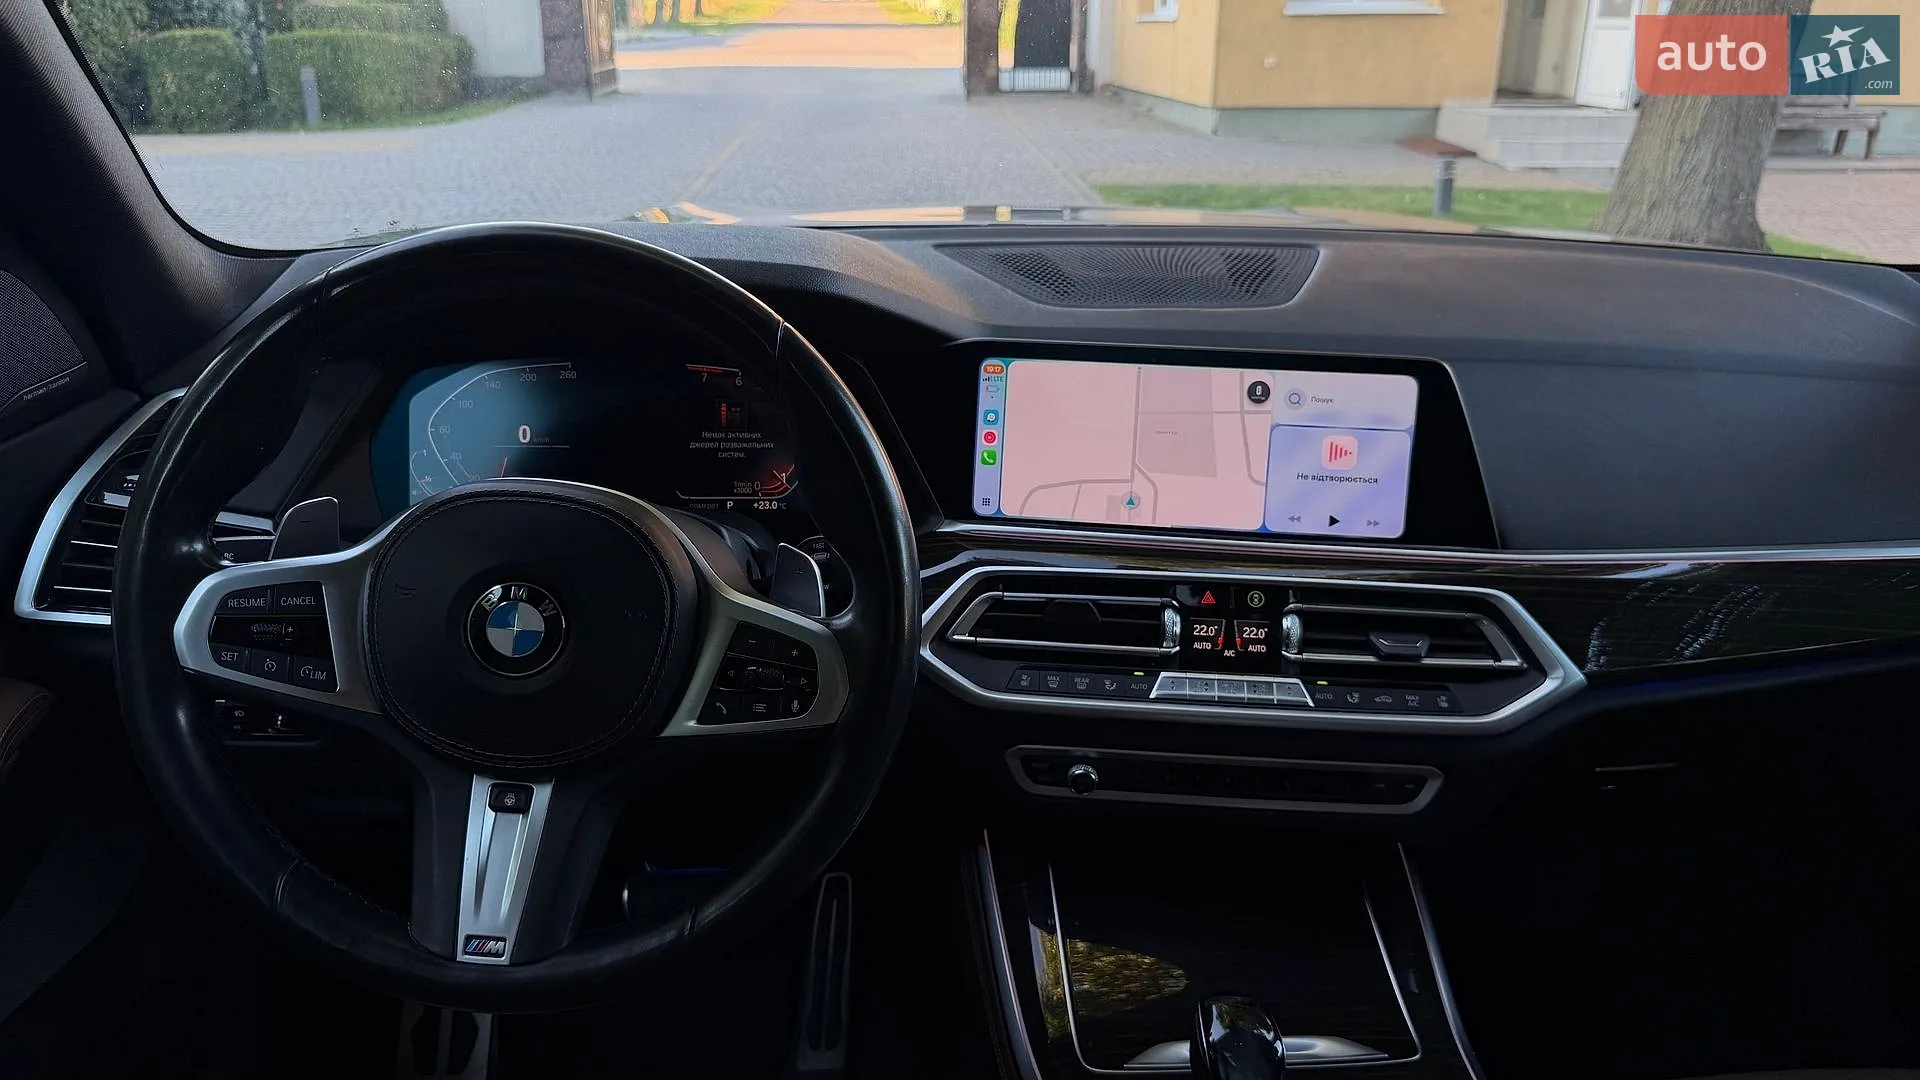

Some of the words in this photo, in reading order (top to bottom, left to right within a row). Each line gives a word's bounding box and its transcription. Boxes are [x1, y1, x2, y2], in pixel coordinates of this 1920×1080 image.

[519, 372, 537, 383] 200
[559, 370, 577, 380] 260
[702, 373, 708, 383] 7
[485, 381, 502, 390] 140
[735, 377, 743, 387] 6
[1256, 385, 1262, 396] 0
[458, 400, 474, 409] 100
[1310, 396, 1334, 404] Пошук
[518, 425, 532, 444] 0
[690, 441, 719, 450] джерел
[721, 442, 775, 450] розважальних
[1296, 472, 1309, 481] Не
[1310, 473, 1378, 485] відтворюється
[754, 481, 761, 491] 0
[727, 502, 734, 510] P
[228, 598, 266, 608] RESUME
[280, 596, 317, 606] CANCEL
[480, 586, 558, 617] BMW
[1193, 642, 1212, 650] AUTO
[1247, 644, 1267, 653] AUTO
[220, 652, 238, 663] SET
[1223, 649, 1236, 657] A/C
[310, 670, 327, 681] LIM
[1130, 682, 1147, 690] AUTO
[1315, 692, 1333, 700] AUTO
